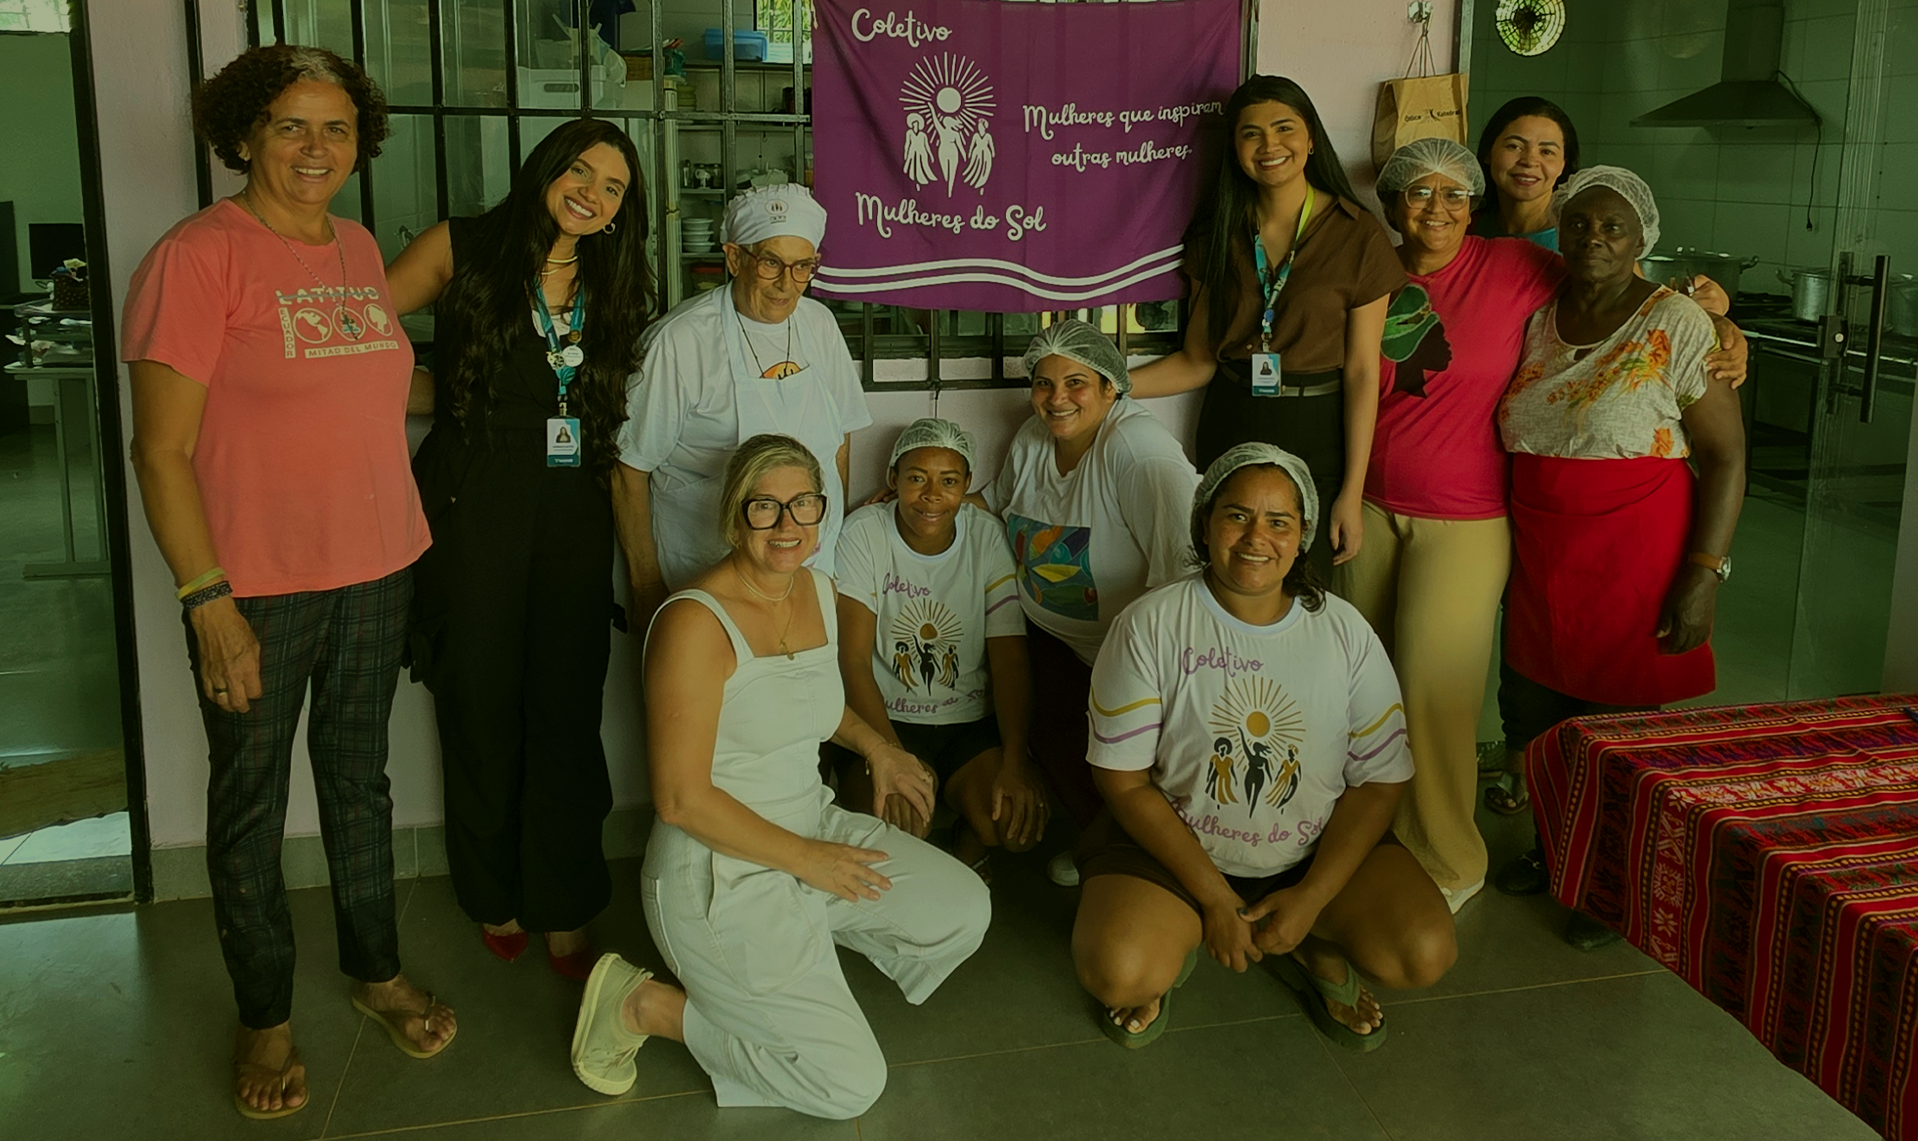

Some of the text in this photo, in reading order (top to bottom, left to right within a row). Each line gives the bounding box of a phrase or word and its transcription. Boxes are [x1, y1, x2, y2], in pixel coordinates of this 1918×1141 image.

[851, 8, 953, 48] Coletivo
[1023, 101, 1224, 140] Mulheres que inspiram
[1051, 143, 1112, 172] outras
[855, 192, 1047, 241] Mulheres do Sol
[279, 308, 295, 358] ECUADOR
[308, 341, 397, 357] MITAD DEL MUNDO
[1182, 647, 1263, 678] Coletivo
[885, 697, 938, 714] ulheres
[1267, 822, 1291, 844] do
